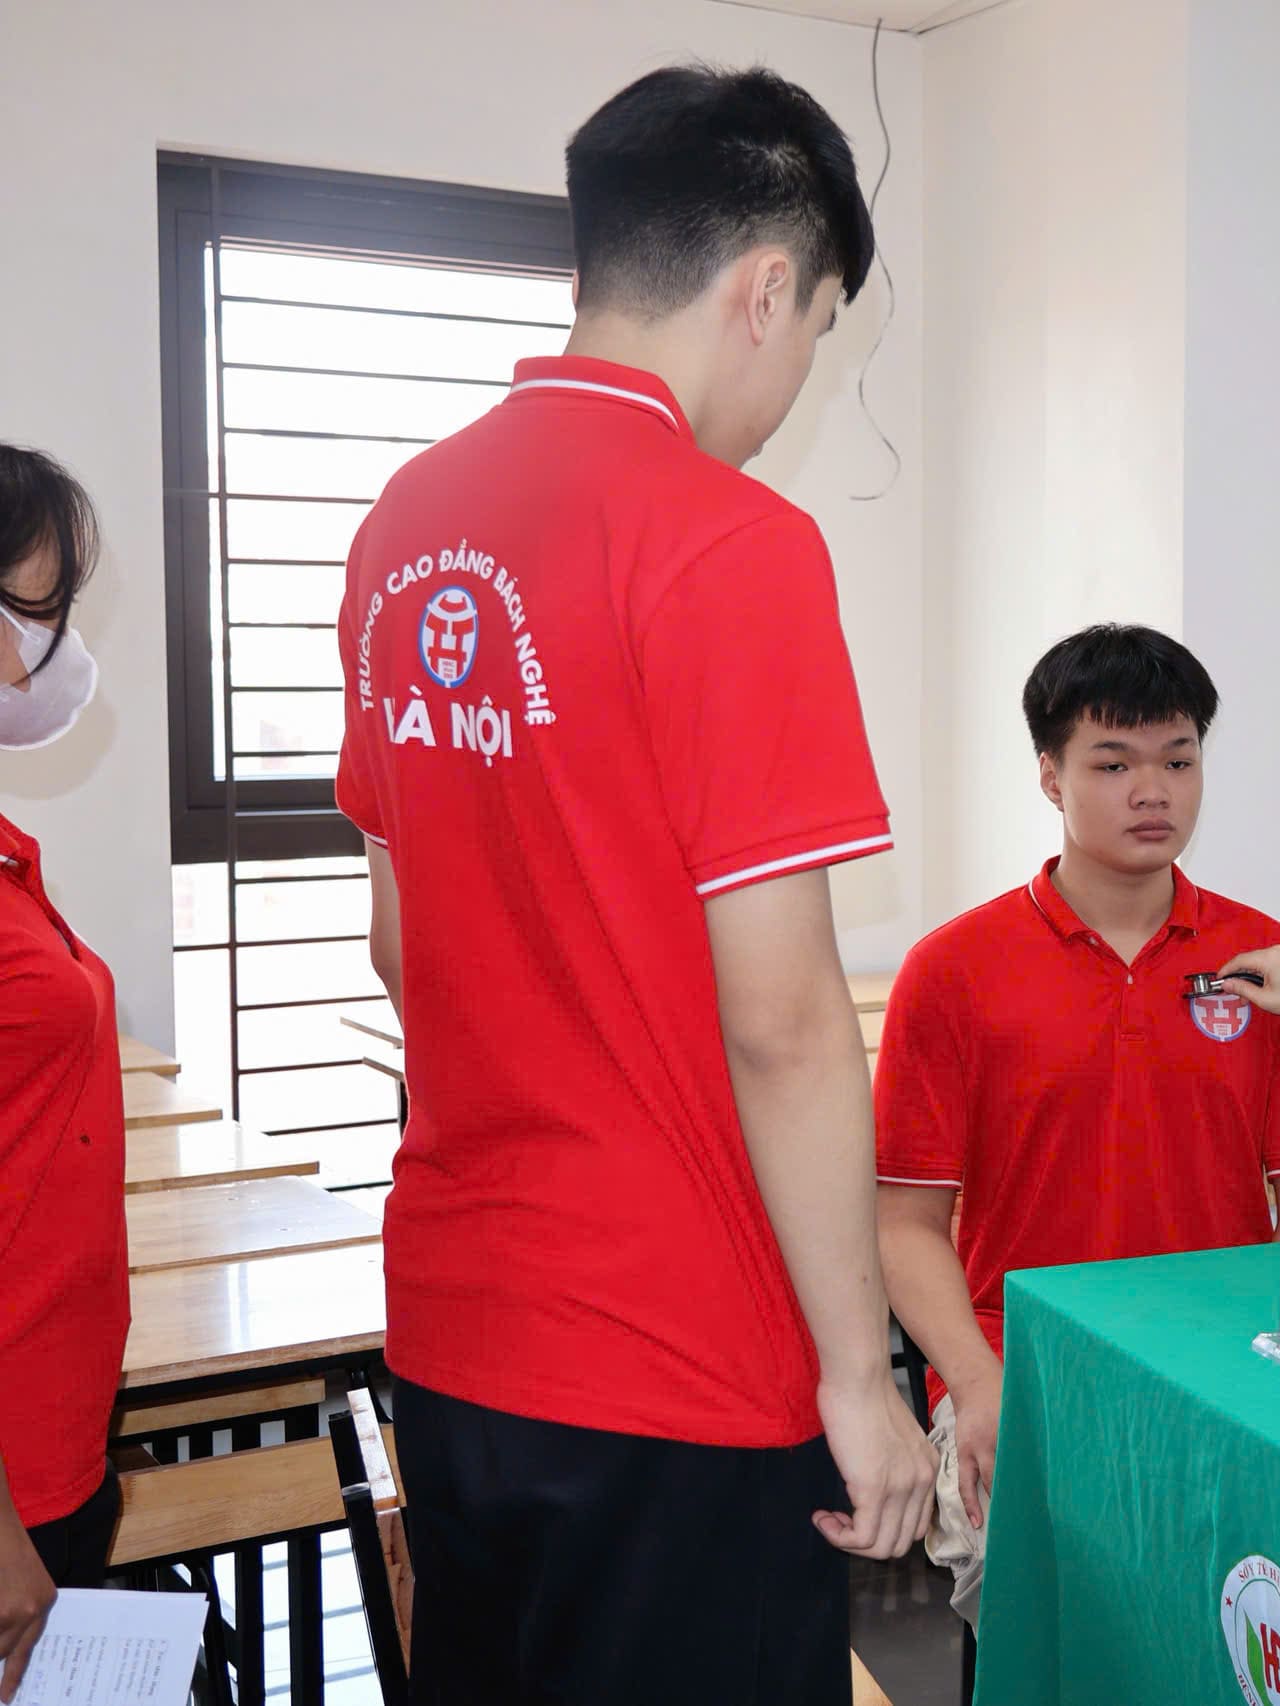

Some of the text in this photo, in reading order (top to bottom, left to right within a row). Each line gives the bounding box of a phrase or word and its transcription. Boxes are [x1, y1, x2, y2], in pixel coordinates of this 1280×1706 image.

[359, 537, 557, 726] TRƯỜNG CAO ĐẲNG BÁCH NGHỆ
[450, 695, 513, 768] NỘI
